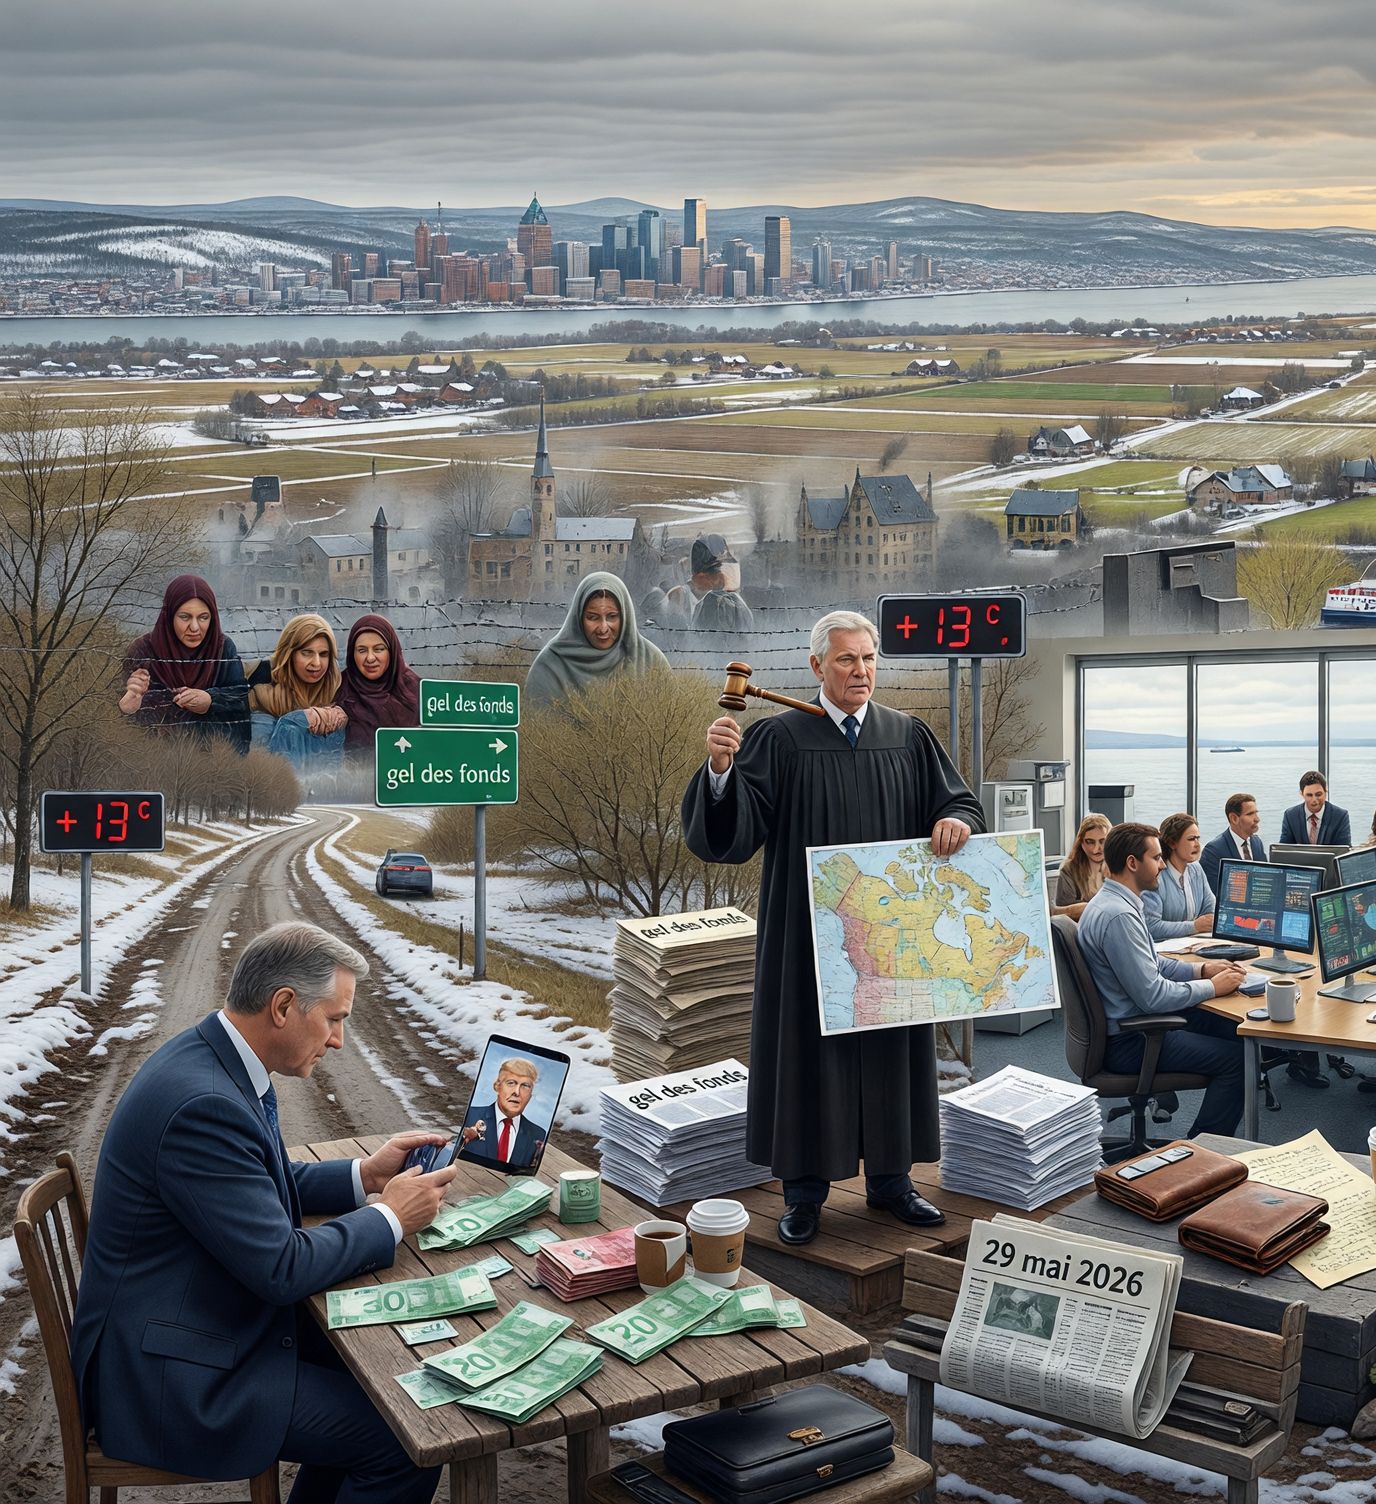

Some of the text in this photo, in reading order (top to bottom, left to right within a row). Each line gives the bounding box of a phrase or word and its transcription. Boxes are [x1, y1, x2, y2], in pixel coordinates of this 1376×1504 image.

[454, 694, 476, 712] des
[386, 762, 511, 790] gel des fonds
[628, 1069, 748, 1110] gel des fonds
[982, 1238, 1144, 1297] 29 mai 2026
[607, 1314, 658, 1346] 20
[451, 1352, 497, 1379] 20
